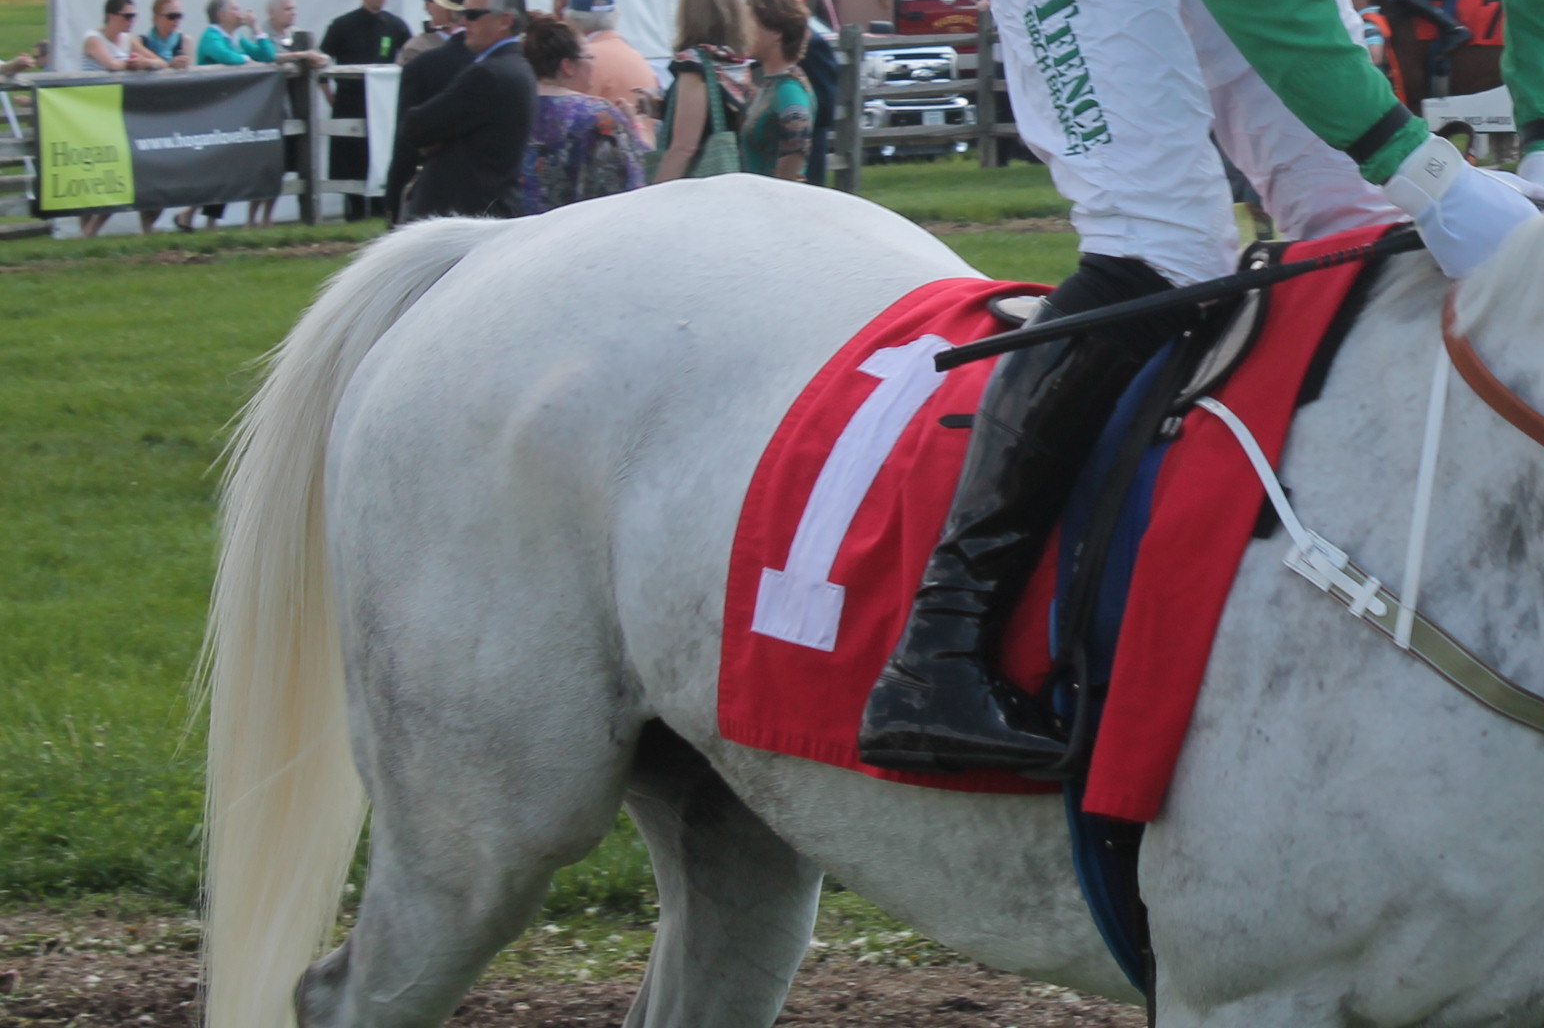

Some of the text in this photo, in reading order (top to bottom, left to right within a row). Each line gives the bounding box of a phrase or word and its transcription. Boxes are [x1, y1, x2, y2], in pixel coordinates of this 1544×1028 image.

[1024, 10, 1081, 156] BIRCH BRANCH
[134, 126, 282, 151] www.hoganlovells.com
[50, 141, 119, 171] Hogan
[51, 169, 127, 199] Lovells
[751, 334, 954, 652] 1
